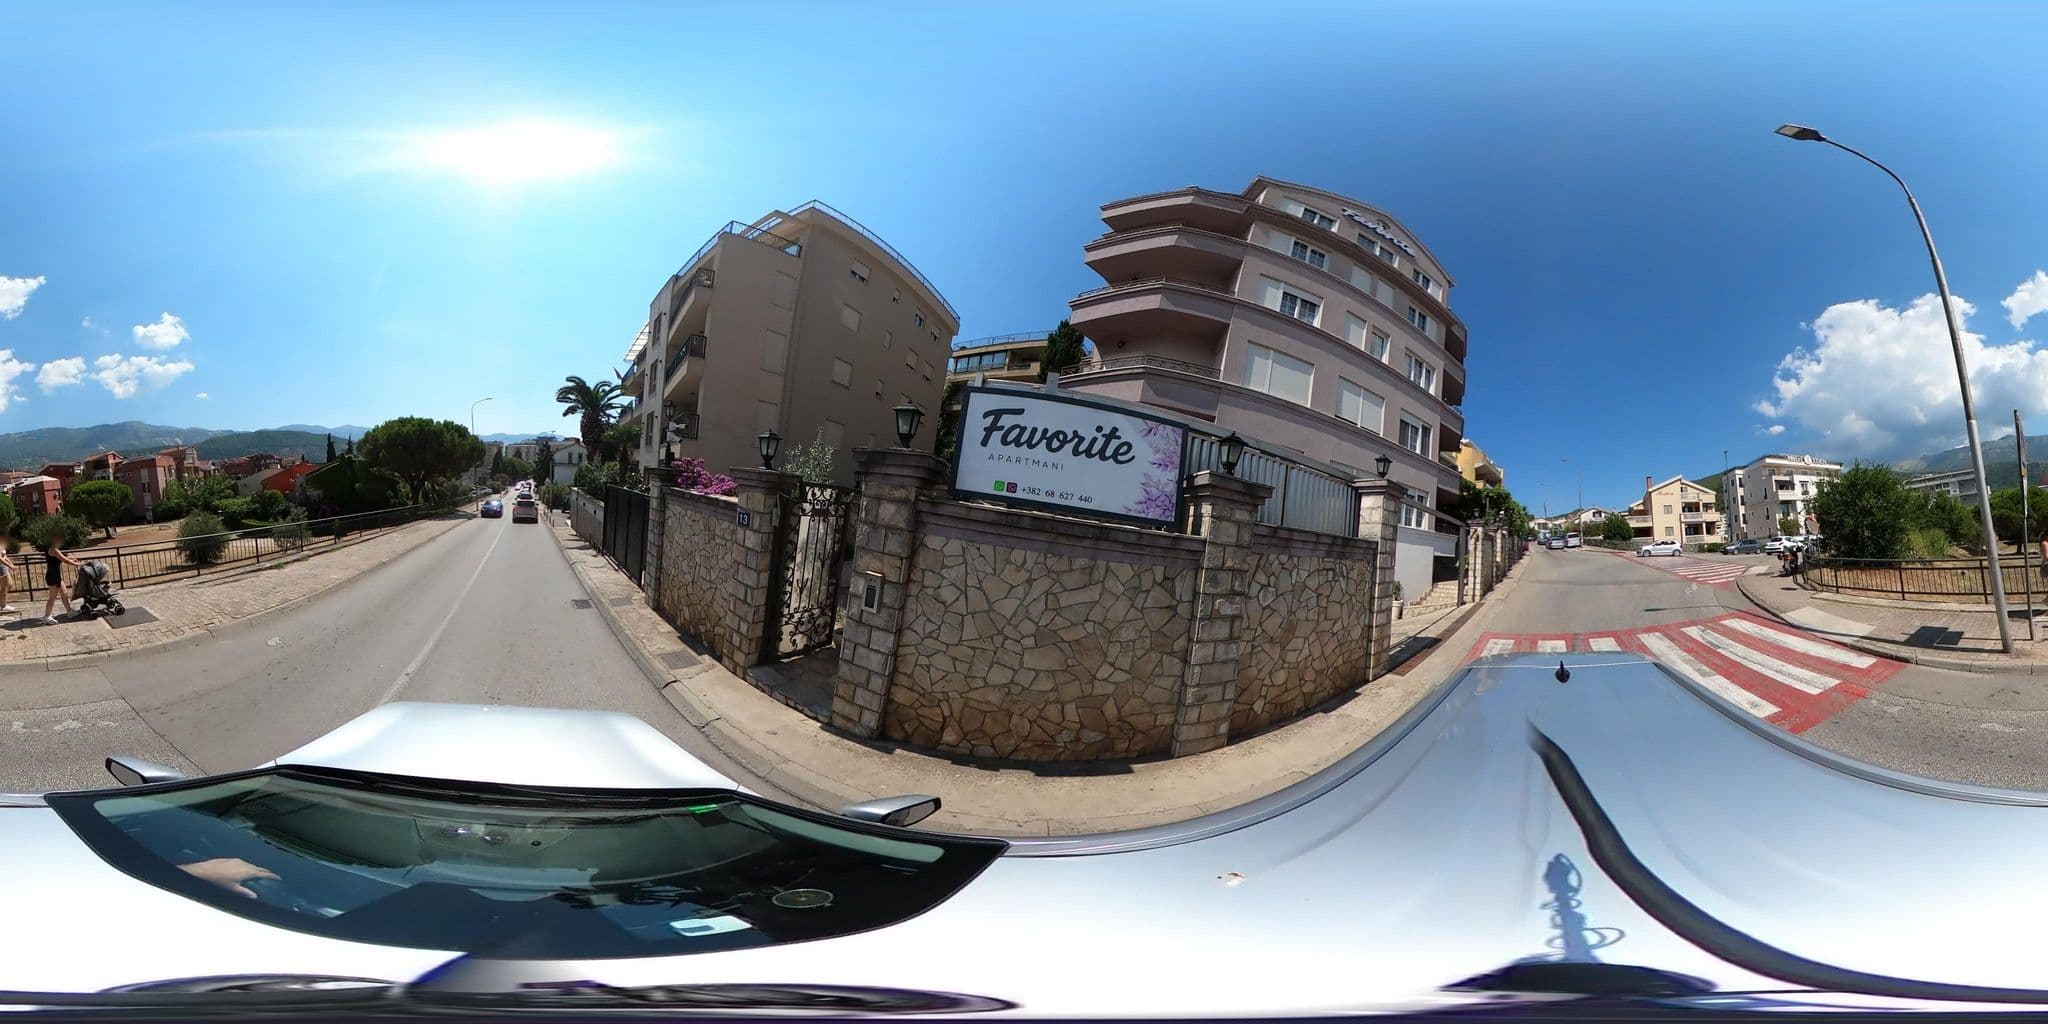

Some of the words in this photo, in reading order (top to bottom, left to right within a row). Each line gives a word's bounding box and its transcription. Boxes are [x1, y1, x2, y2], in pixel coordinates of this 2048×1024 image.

[980, 408, 1135, 465] Favorite
[988, 453, 1065, 471] APARTMANI
[1021, 487, 1041, 496] +382
[1045, 489, 1055, 498] 68
[1059, 490, 1074, 501] 627
[1077, 494, 1093, 504] 440
[739, 513, 748, 525] 13
